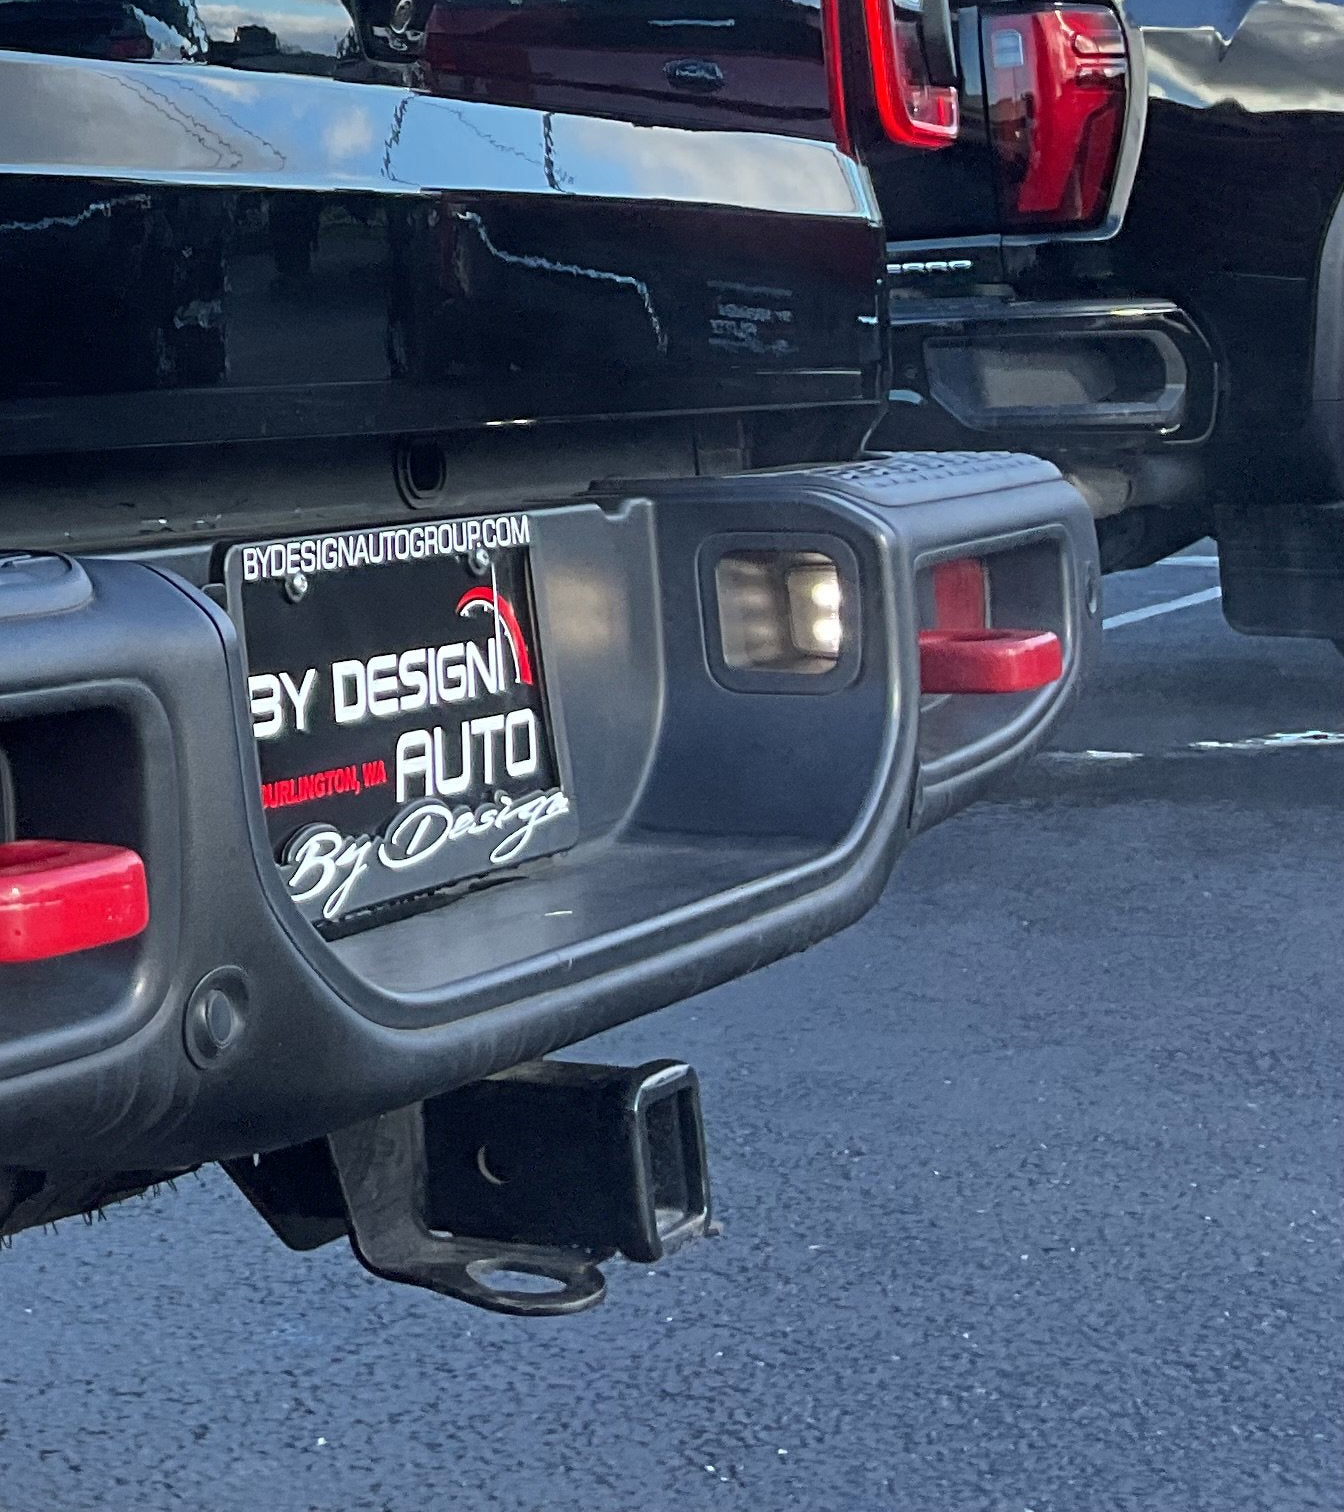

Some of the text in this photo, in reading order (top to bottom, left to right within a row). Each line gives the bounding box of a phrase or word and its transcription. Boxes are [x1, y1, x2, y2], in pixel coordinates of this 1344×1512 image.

[242, 514, 531, 582] BYDESIGNAUTOGROUP.COM
[247, 637, 497, 739] BY DESIGN
[362, 759, 388, 788] WA
[395, 707, 538, 804] AUTO
[288, 790, 570, 919] By Design
